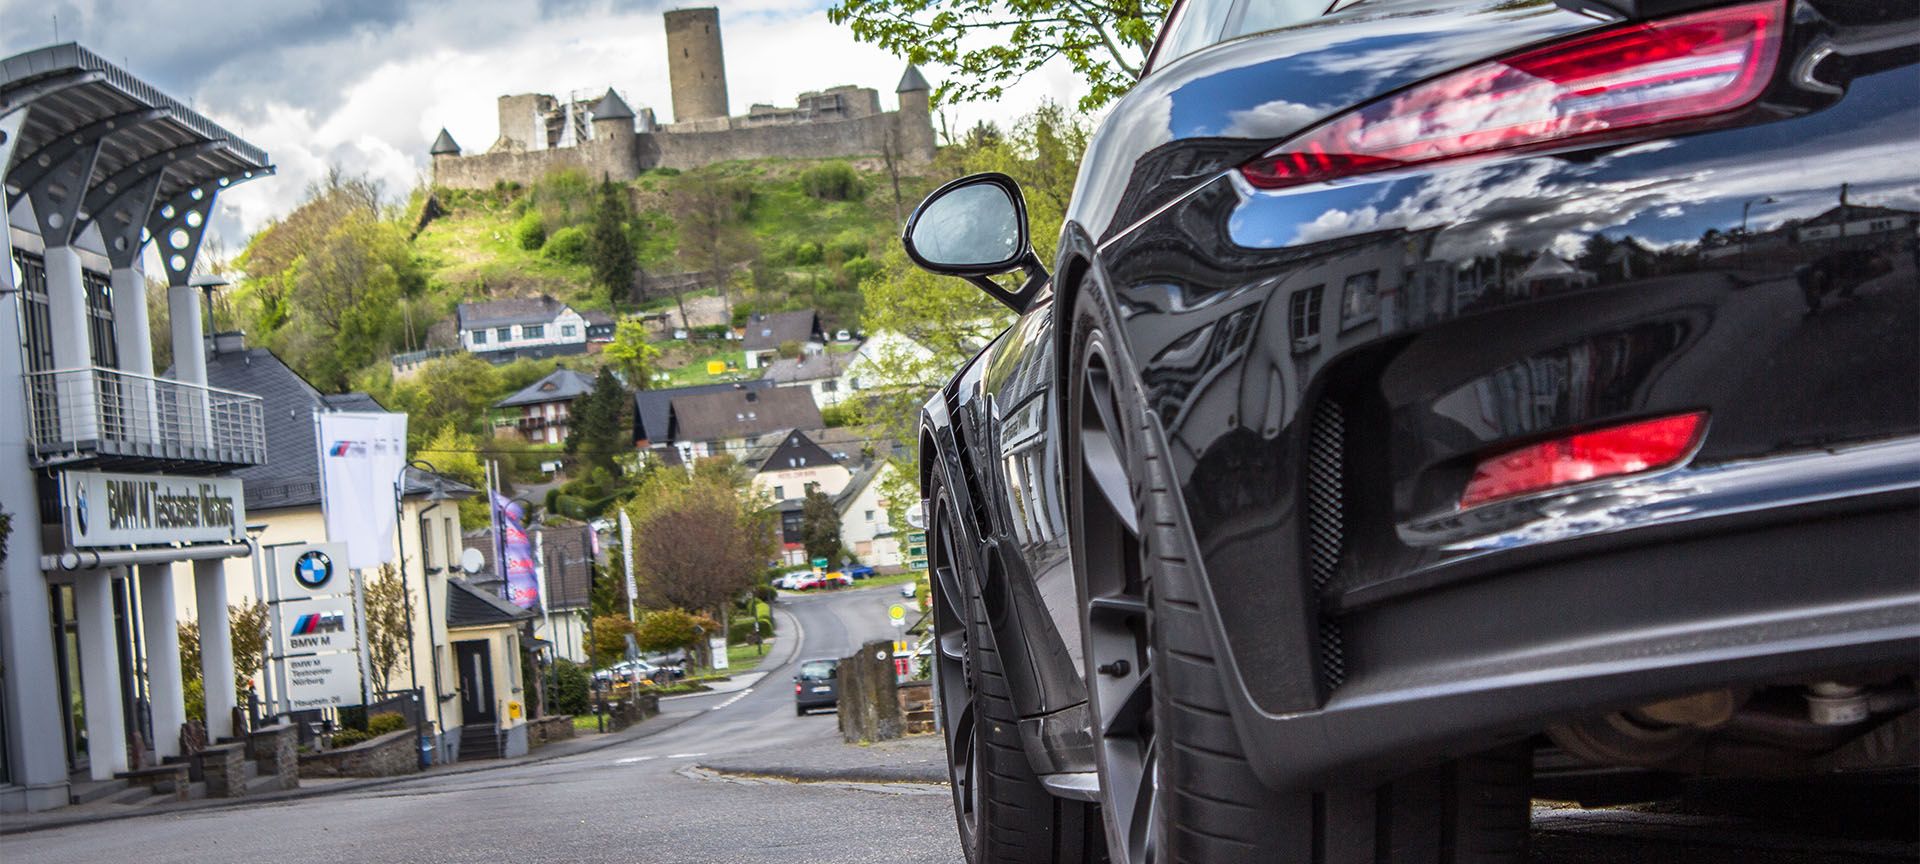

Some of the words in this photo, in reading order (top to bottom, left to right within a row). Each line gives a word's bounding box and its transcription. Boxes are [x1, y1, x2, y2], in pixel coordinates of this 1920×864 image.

[107, 480, 137, 530] BMW
[138, 480, 151, 529] M
[150, 481, 199, 529] Testcenter
[290, 637, 319, 649] BMW
[321, 636, 331, 645] M
[291, 660, 312, 669] BMW
[291, 668, 333, 677] Testcenter
